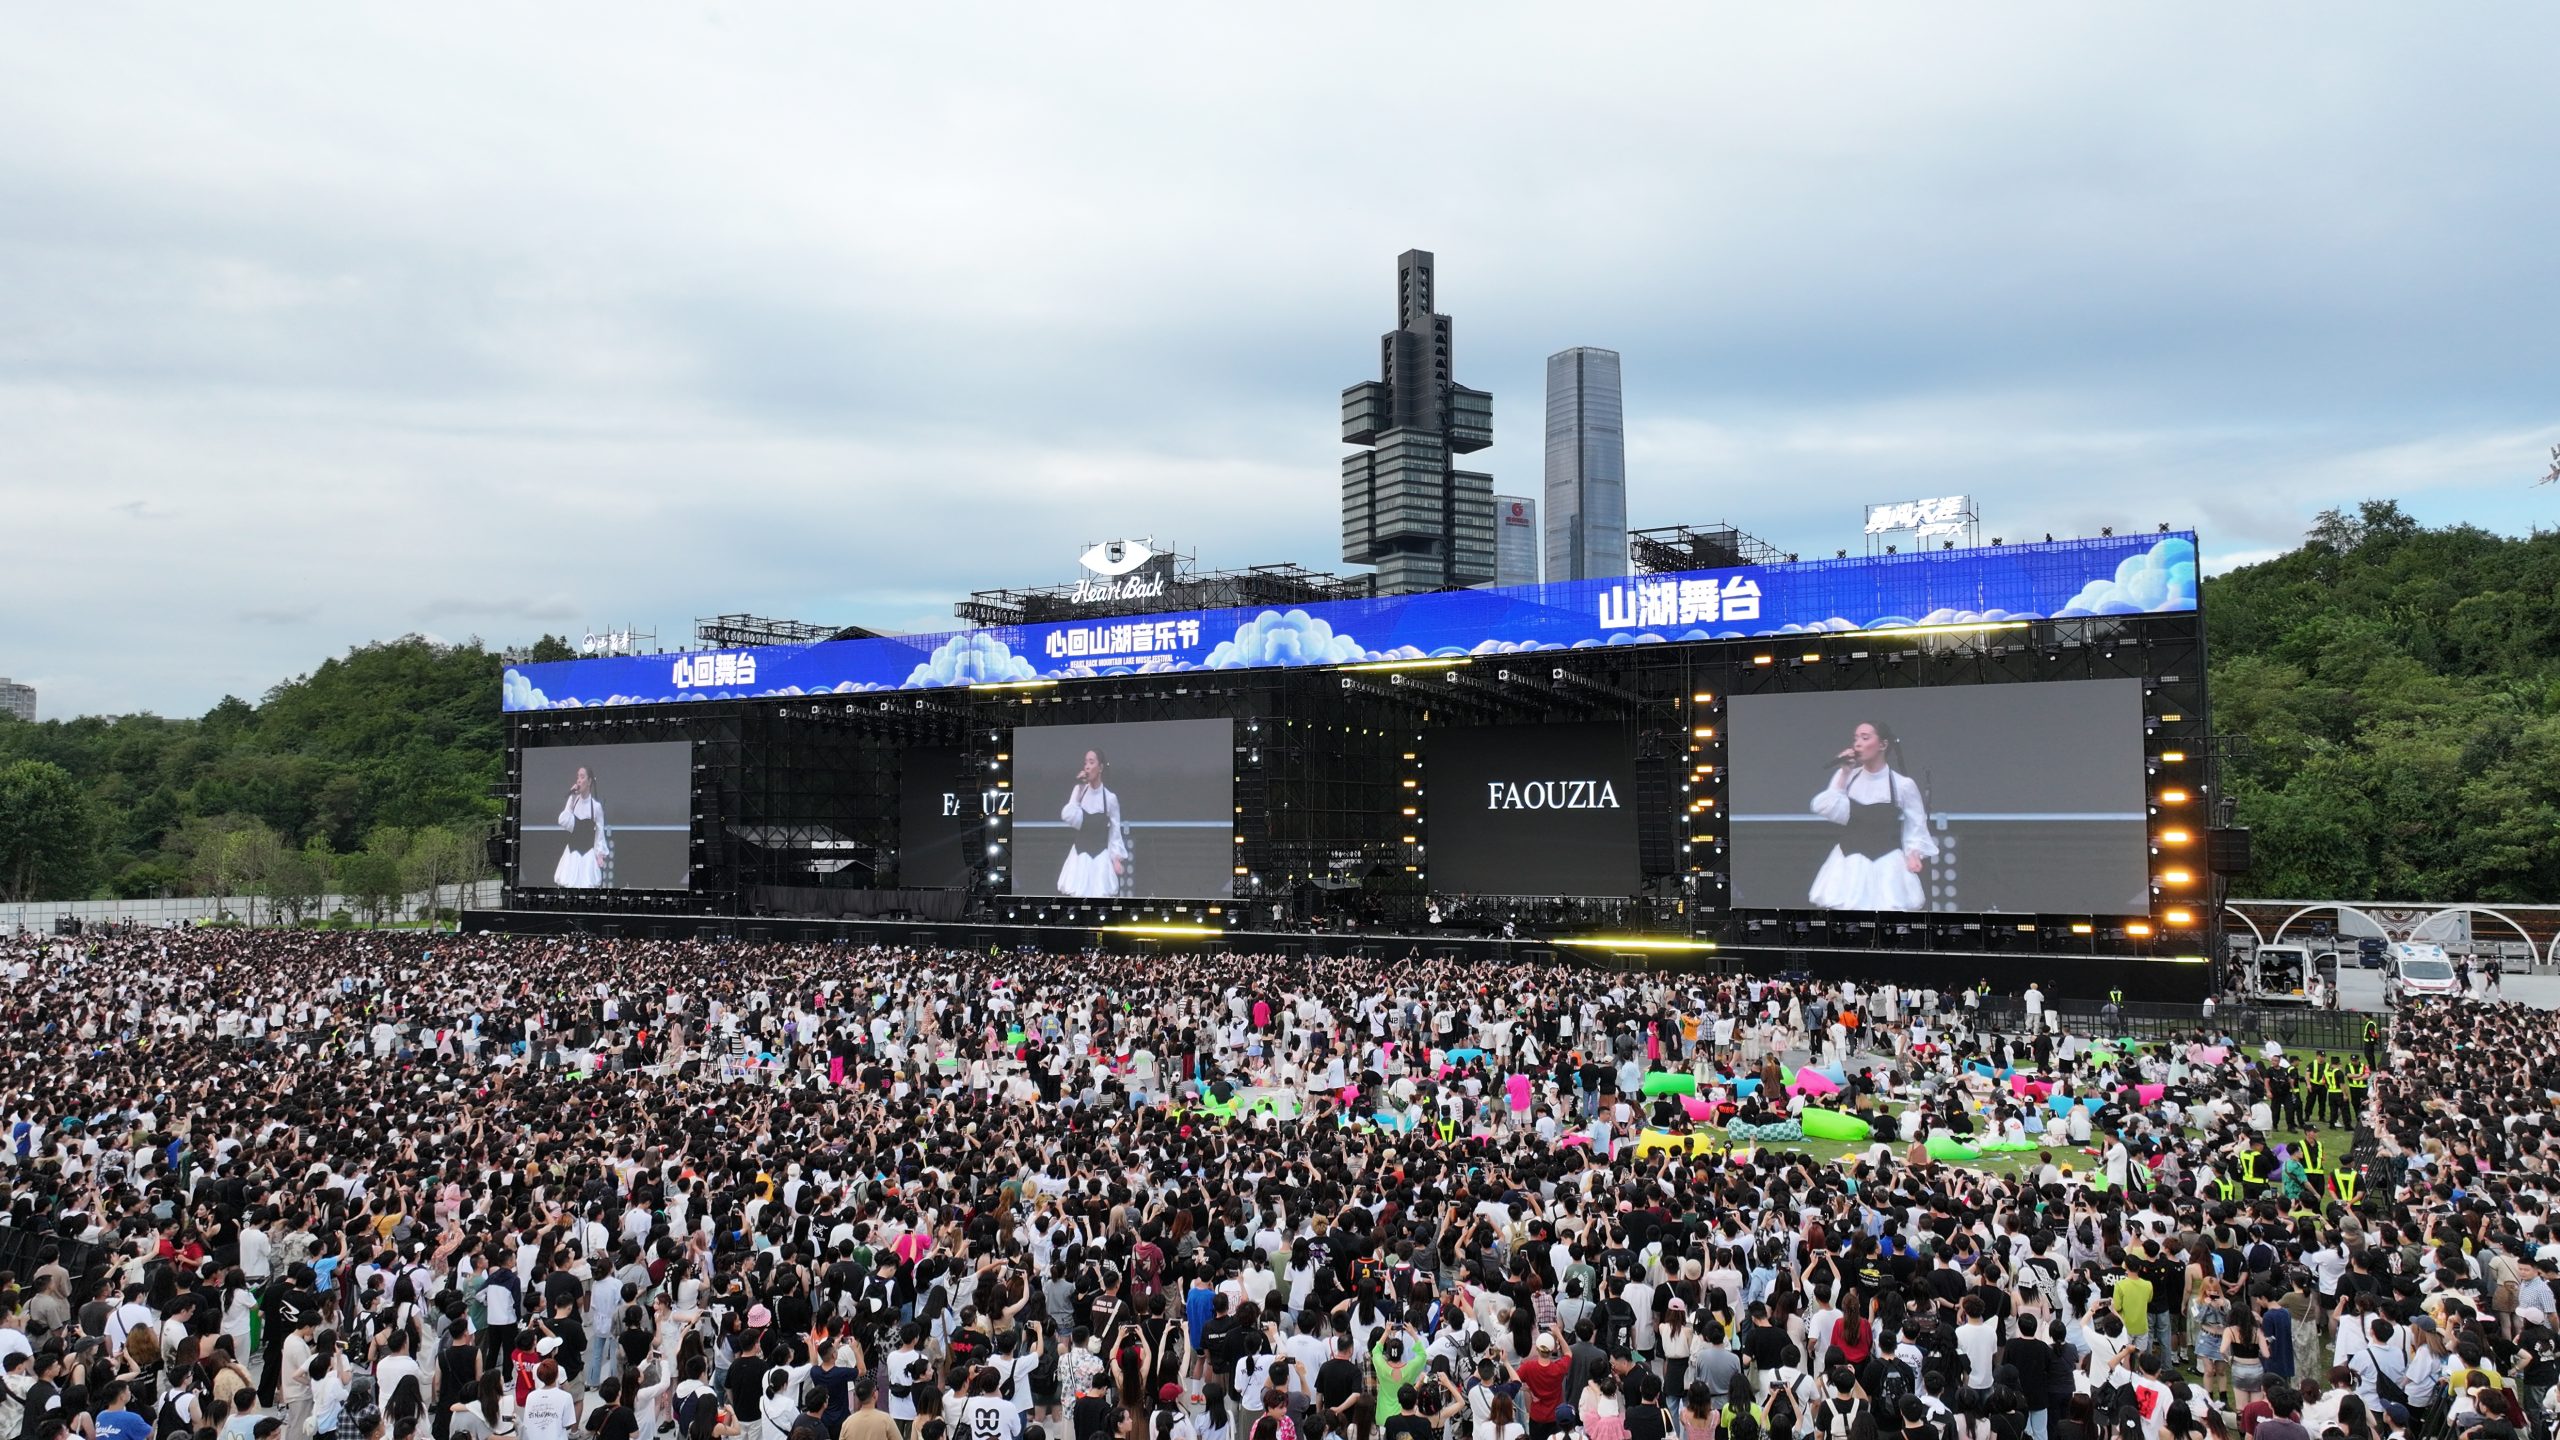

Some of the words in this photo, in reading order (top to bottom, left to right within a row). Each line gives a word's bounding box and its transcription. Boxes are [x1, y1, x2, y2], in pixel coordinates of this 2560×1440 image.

[1071, 579, 1122, 604] Heart
[1121, 571, 1164, 599] Back
[1599, 575, 1762, 629] 山湖舞台
[1045, 619, 1200, 658] 心回山湖音乐节
[672, 652, 756, 688] 心回舞台
[1487, 780, 1620, 810] FAOUZIA
